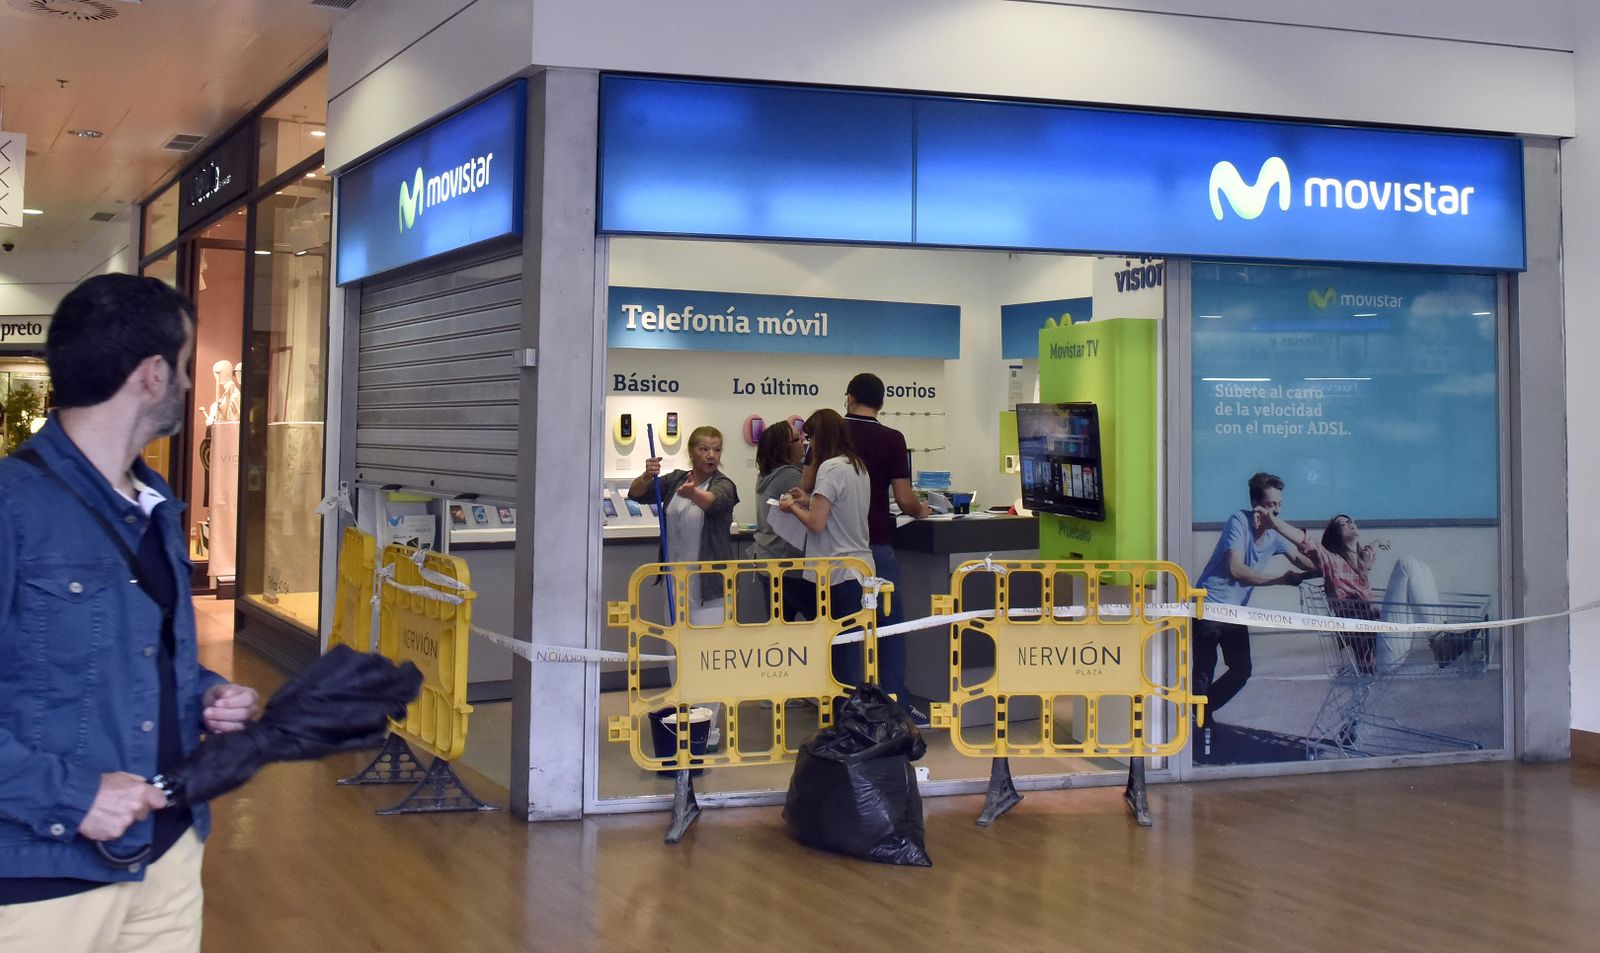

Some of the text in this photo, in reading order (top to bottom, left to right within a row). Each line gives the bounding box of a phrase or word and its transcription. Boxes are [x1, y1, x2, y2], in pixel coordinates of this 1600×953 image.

[426, 152, 493, 208] movistar
[1304, 177, 1475, 216] movistar
[1340, 292, 1403, 309] movistar
[621, 303, 829, 338] Telefonía móvil
[1, 321, 42, 342] preto
[1050, 338, 1099, 360] Movistar TV
[613, 372, 680, 393] Básico
[733, 376, 819, 397] Lo último
[1214, 382, 1267, 399] Súbete
[1270, 384, 1283, 399] al
[1286, 387, 1324, 400] carro
[1215, 402, 1323, 418] de la velocidad
[1215, 420, 1352, 439] con el mejor ADSL.
[700, 642, 808, 671] NERVIÓN
[1018, 641, 1121, 666] NERVIÓN
[760, 670, 789, 679] PLAZA
[1075, 668, 1103, 676] PLAZA
